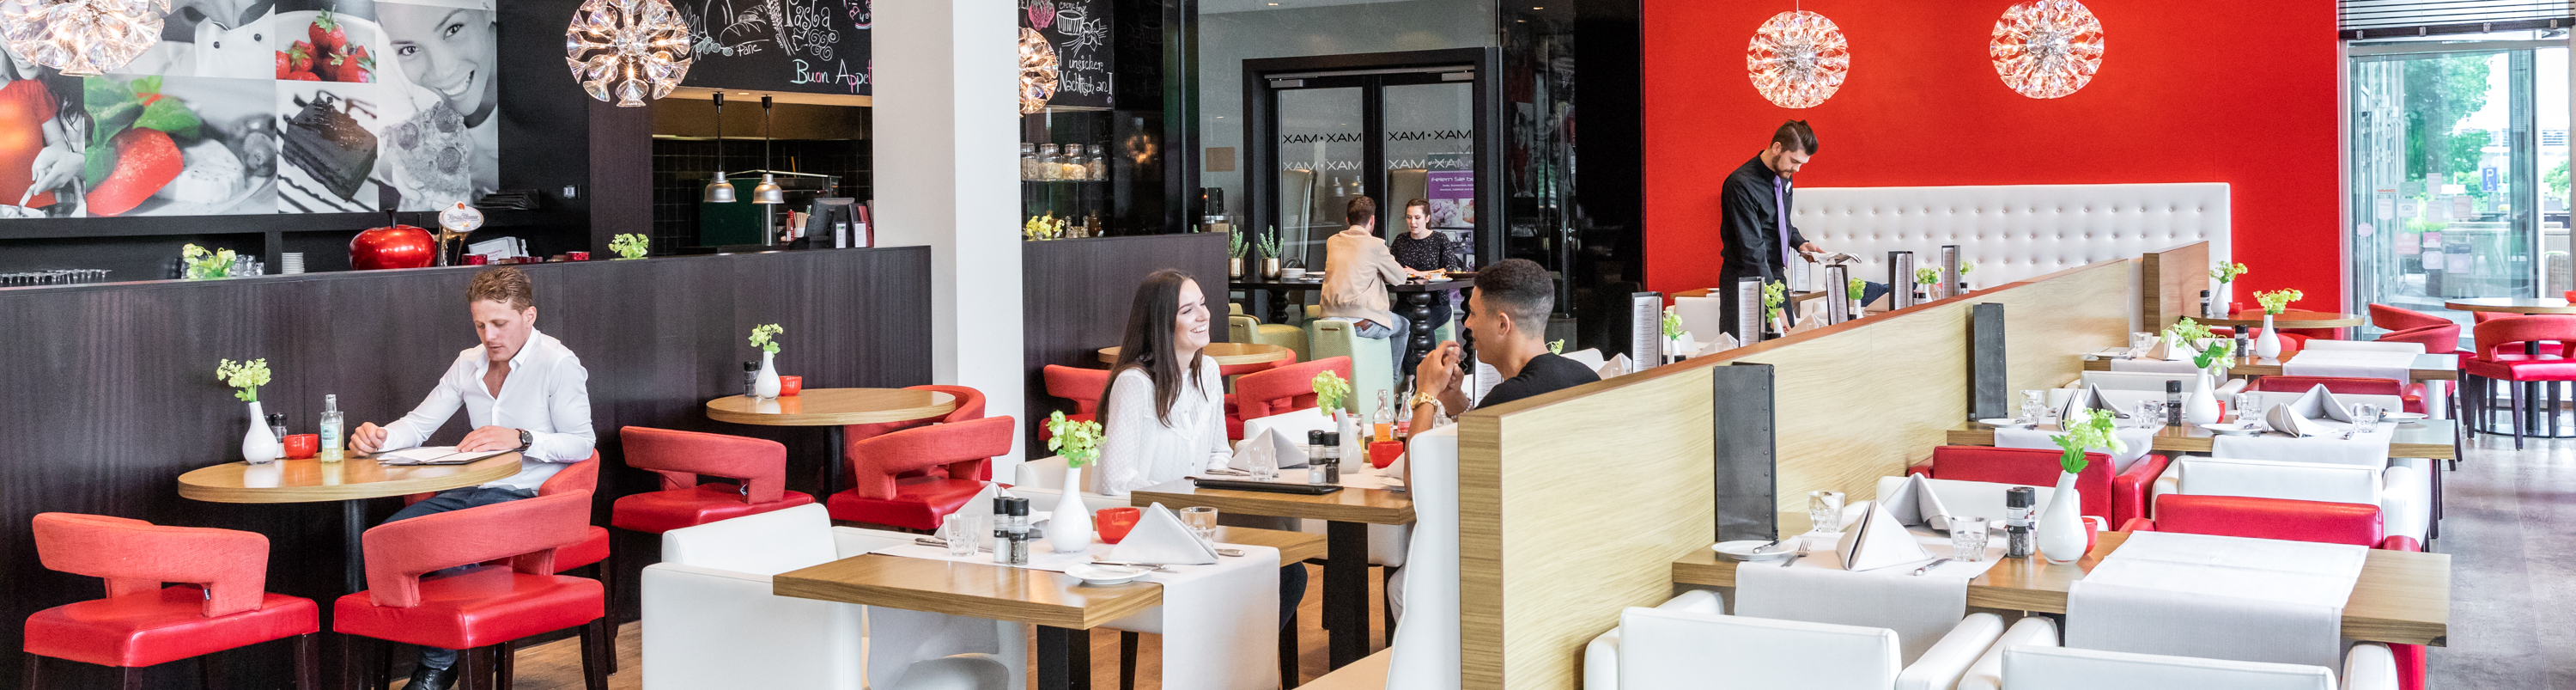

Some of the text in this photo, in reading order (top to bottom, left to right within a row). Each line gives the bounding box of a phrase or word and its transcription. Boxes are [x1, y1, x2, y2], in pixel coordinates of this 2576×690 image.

[736, 44, 762, 58] Pane
[790, 58, 829, 84] Buon
[2486, 168, 2494, 181] P
